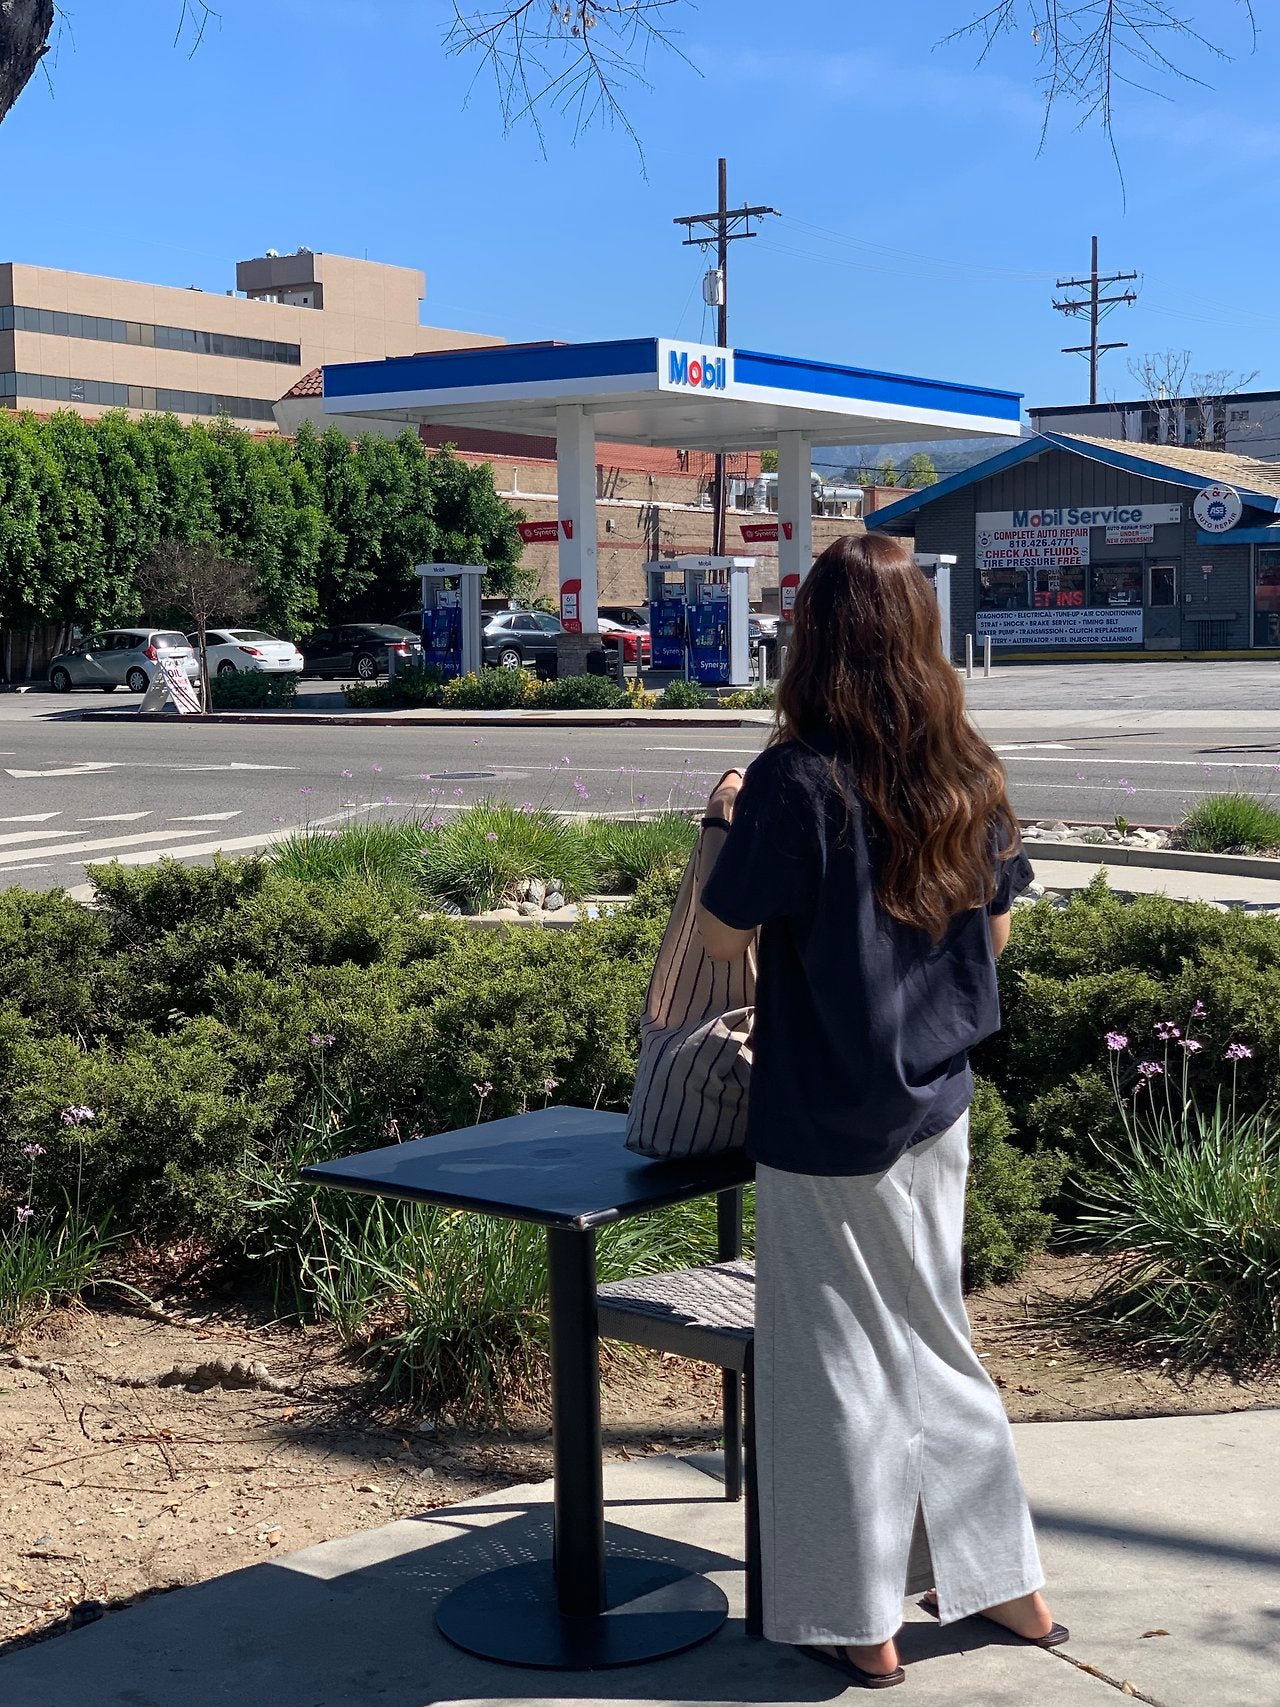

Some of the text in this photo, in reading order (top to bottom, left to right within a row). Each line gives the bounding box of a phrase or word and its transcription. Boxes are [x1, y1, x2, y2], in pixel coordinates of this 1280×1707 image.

[669, 350, 726, 390] Mobil
[1200, 487, 1232, 500] T & T
[1012, 507, 1142, 527] Mobil Service
[1197, 512, 1236, 529] AUTO REPAIR
[994, 530, 1035, 540] COMPLETE
[1037, 529, 1057, 538] AUTO
[1060, 528, 1088, 537] REPAIR
[1010, 538, 1074, 548] 818.426.4771
[986, 547, 1079, 558] CHECK ALL FLUIDS
[1007, 557, 1055, 566] PRESSURE
[1058, 557, 1081, 565] FREE
[700, 660, 727, 670] Synergy
